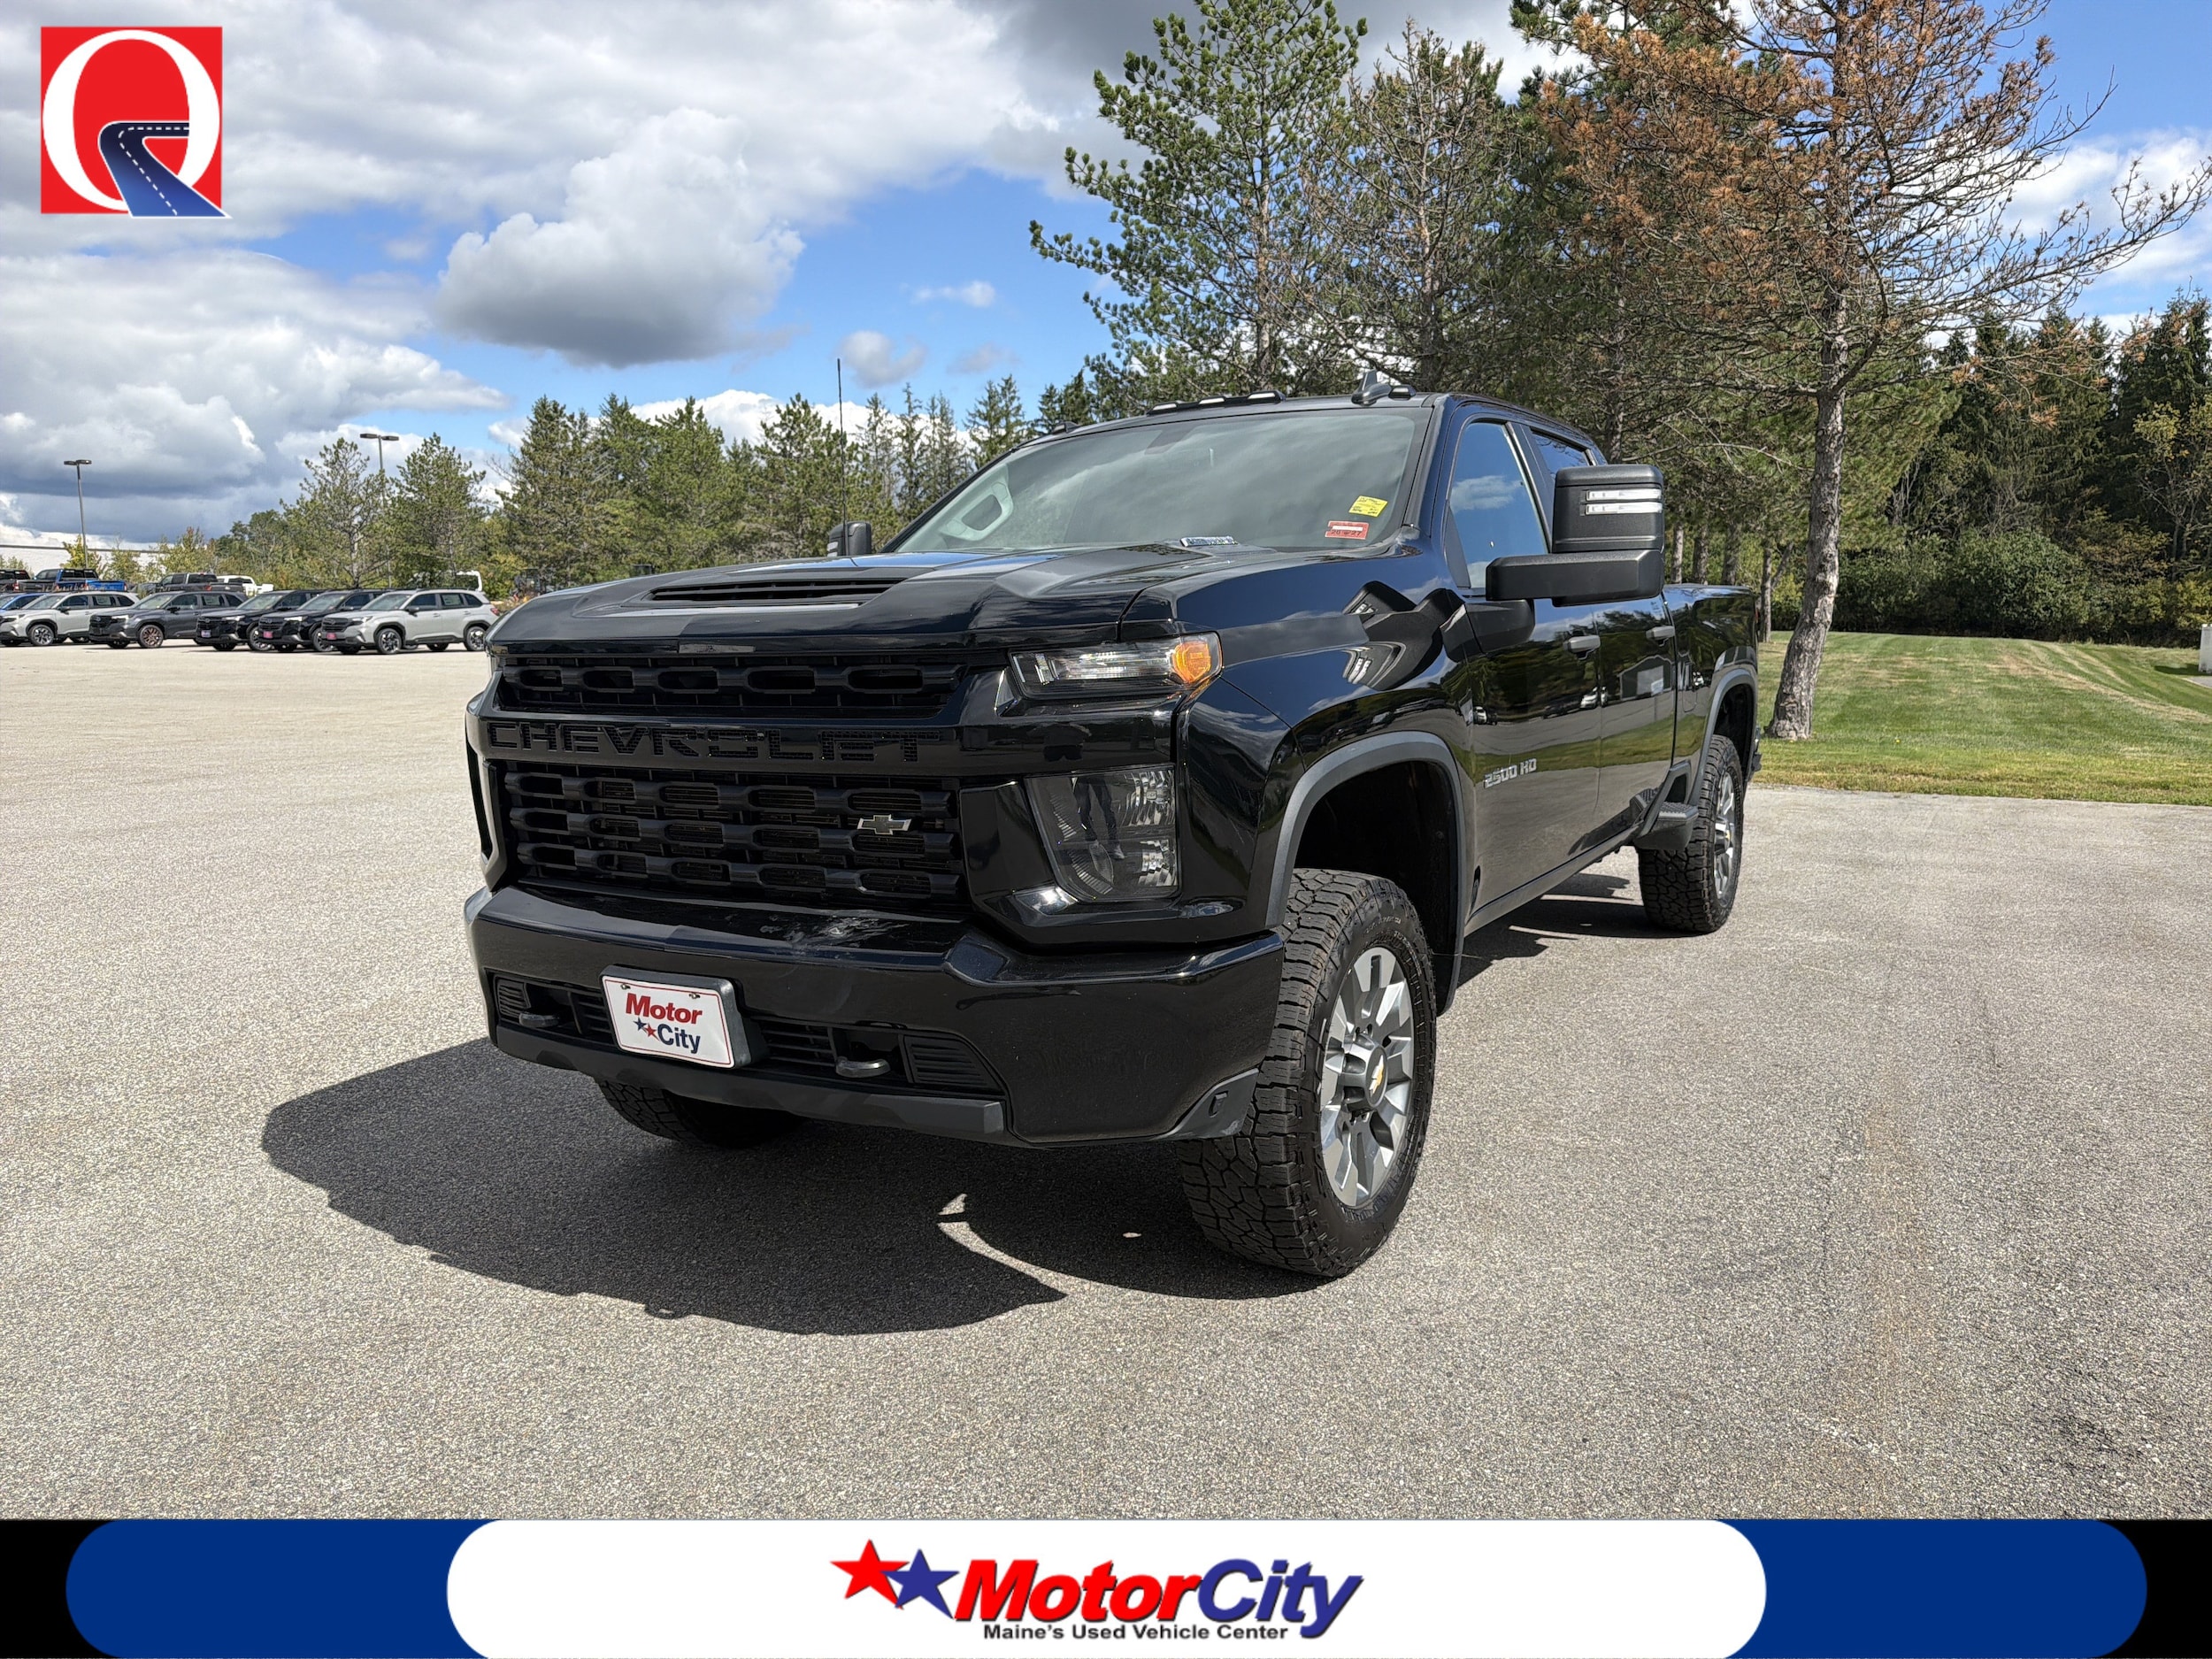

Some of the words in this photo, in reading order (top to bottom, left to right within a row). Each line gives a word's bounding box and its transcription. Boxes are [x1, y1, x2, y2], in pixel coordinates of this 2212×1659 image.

[487, 721, 941, 763] CHEVROLET
[1484, 765, 1517, 788] 2500
[1520, 758, 1537, 775] HD
[626, 993, 703, 1025] Motor
[657, 1023, 701, 1055] City
